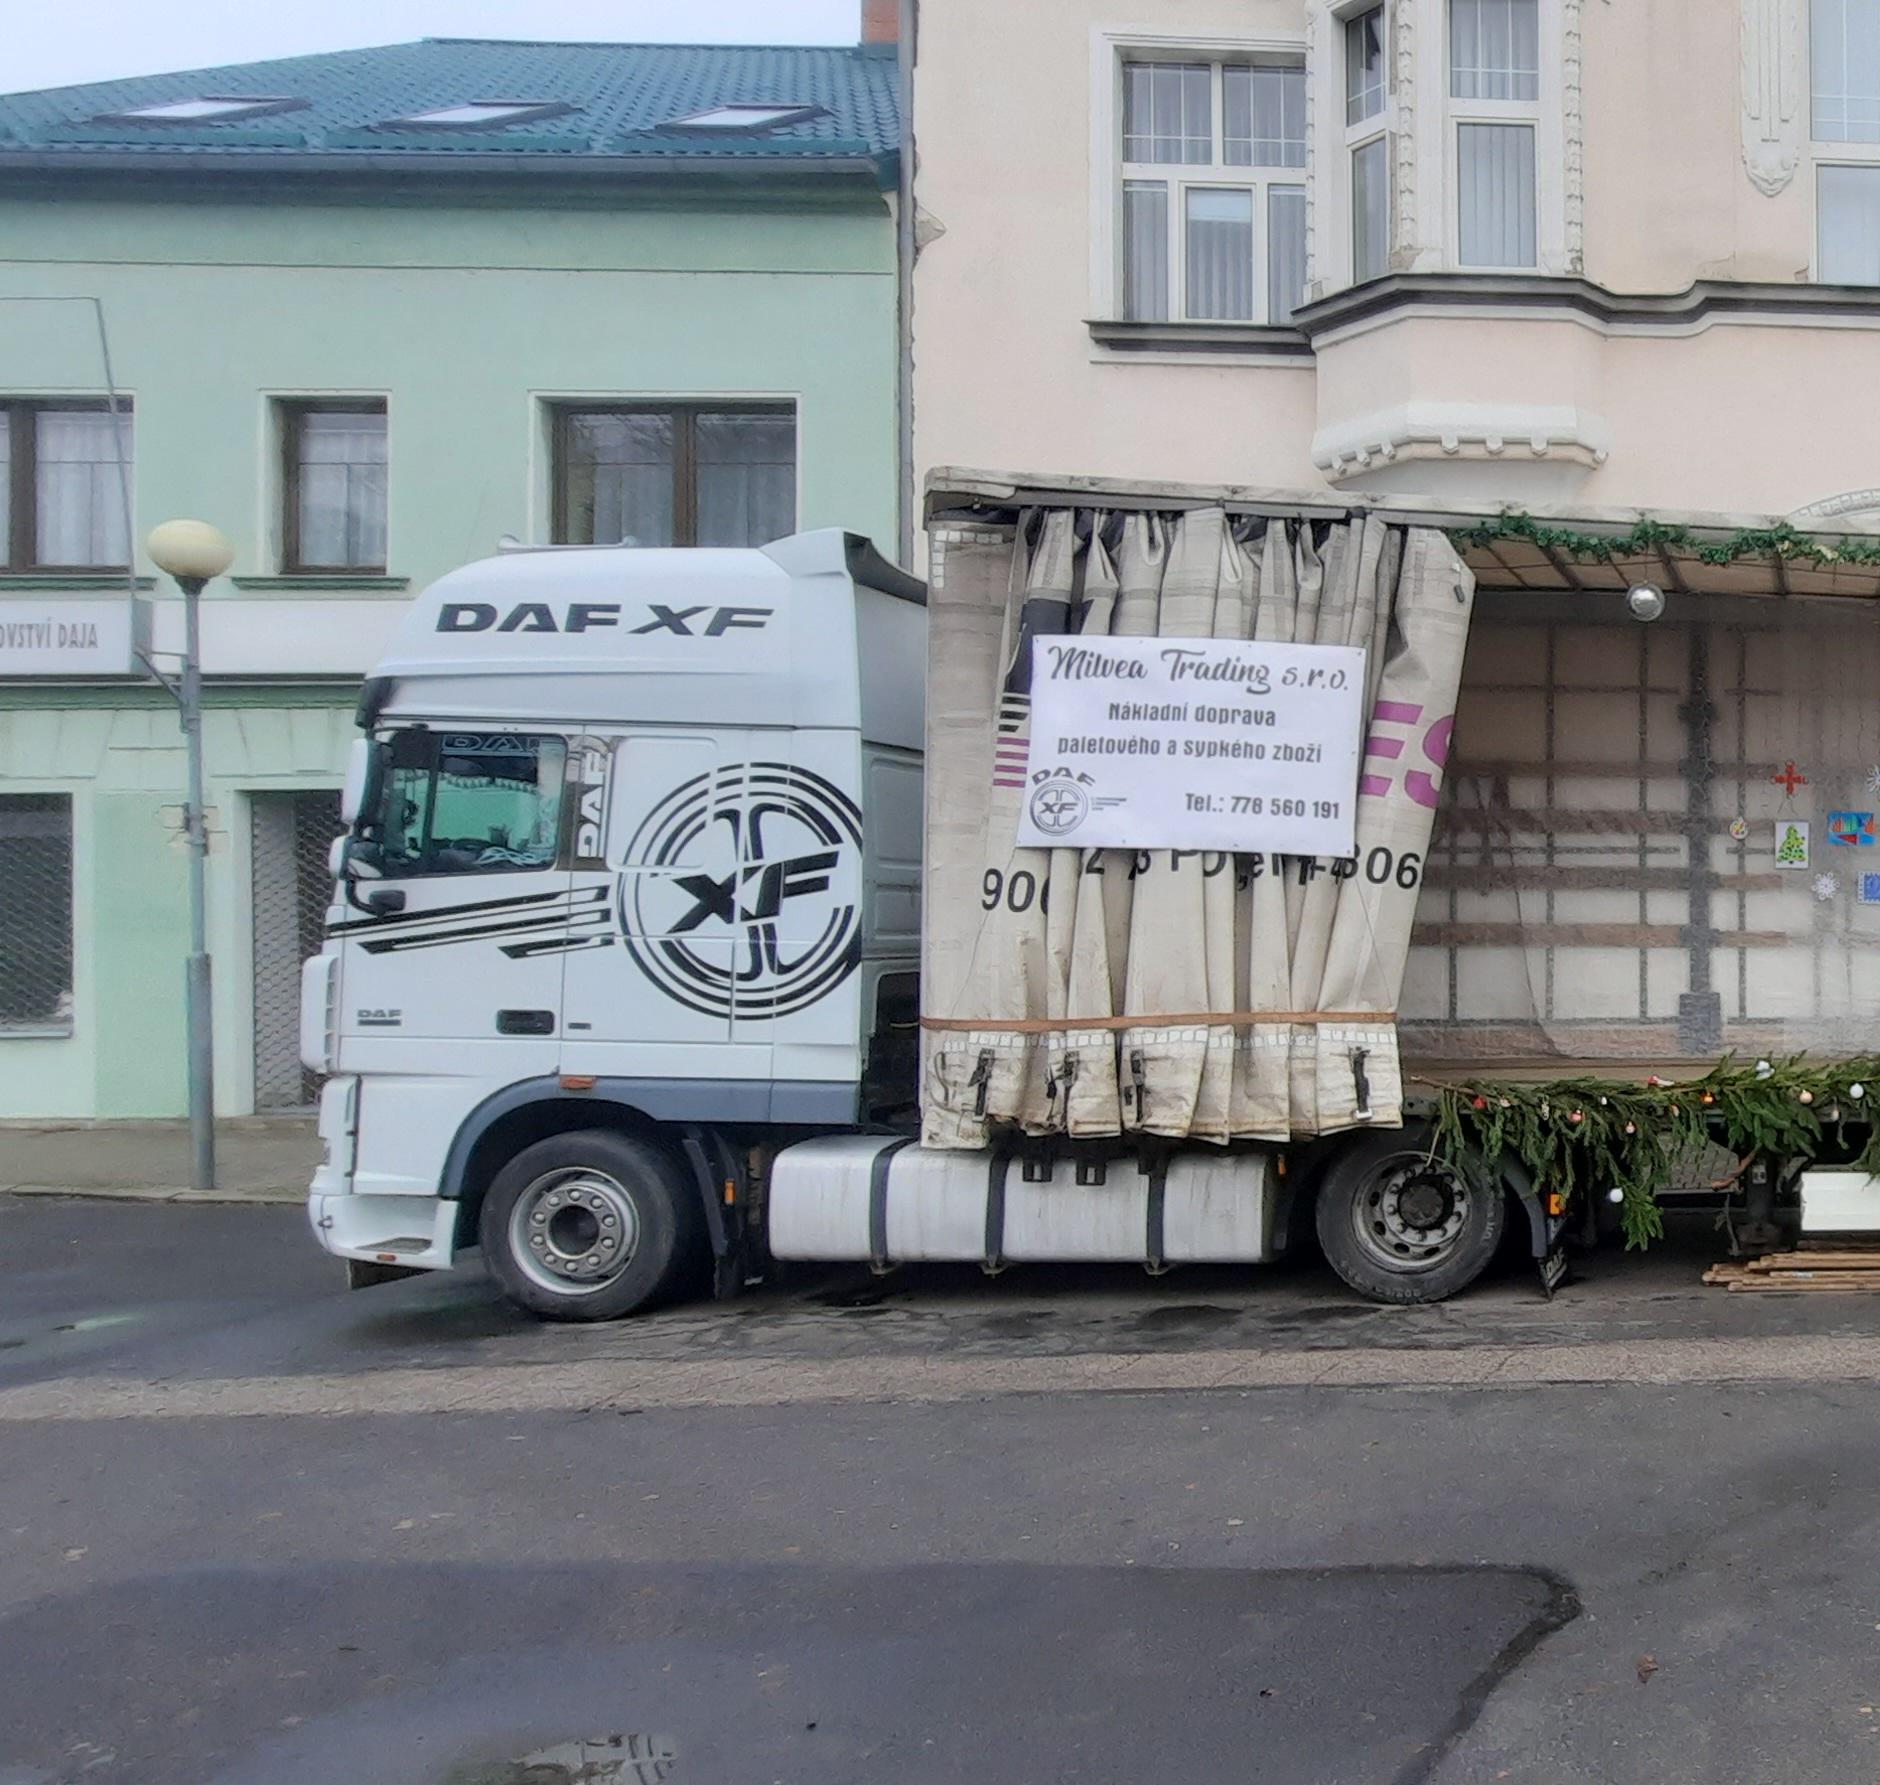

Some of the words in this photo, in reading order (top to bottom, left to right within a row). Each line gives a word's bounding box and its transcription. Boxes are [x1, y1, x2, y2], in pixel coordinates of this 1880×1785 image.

[435, 603, 622, 633] DAF
[626, 604, 775, 637] XF
[58, 623, 98, 649] DAJA
[1048, 646, 1148, 681] Milvea
[1160, 649, 1272, 695] Trading
[1281, 666, 1350, 691] s.r.o.
[1108, 701, 1189, 723] Nákladní
[1194, 704, 1276, 727] doprava
[1057, 735, 1161, 755] paletového
[1167, 739, 1178, 755] a
[1183, 739, 1267, 760] sypkého
[1272, 743, 1322, 763] zboží
[1031, 766, 1096, 786] DAF
[1185, 793, 1224, 813] Tel.:
[1230, 796, 1262, 815] 778
[1270, 798, 1305, 818] 560
[1312, 801, 1340, 819] 191
[666, 850, 840, 935] XF
[981, 868, 1050, 916] 90
[357, 1009, 402, 1018] DAF
